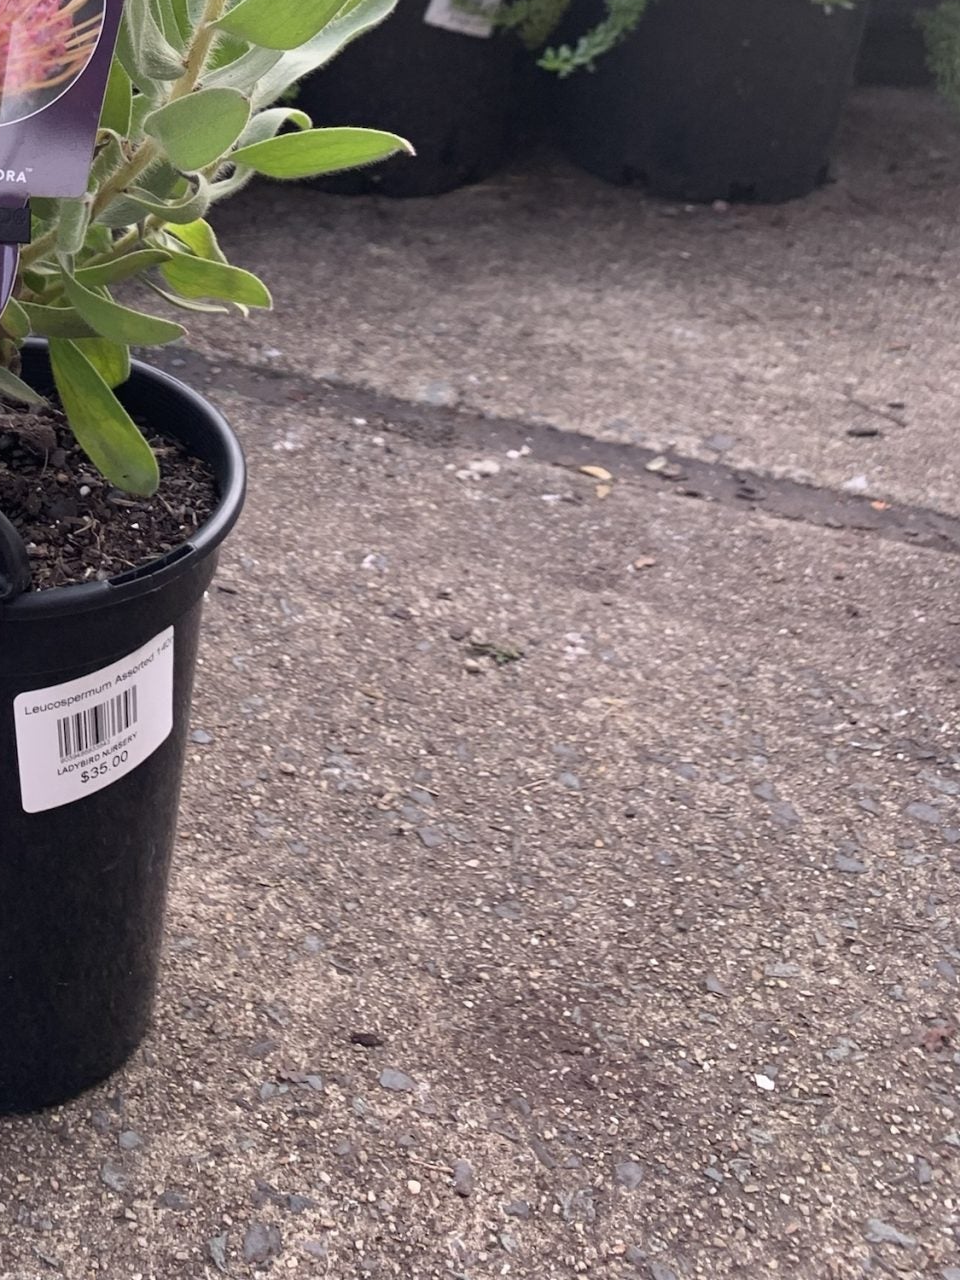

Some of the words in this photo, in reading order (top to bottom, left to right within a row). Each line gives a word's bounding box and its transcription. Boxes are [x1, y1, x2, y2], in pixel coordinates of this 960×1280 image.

[24, 681, 112, 715] Leucospermum
[115, 652, 154, 685] Assorted
[57, 754, 100, 776] LADYBIRD
[102, 731, 138, 757] NURSERY
[81, 750, 128, 783] $35.00
